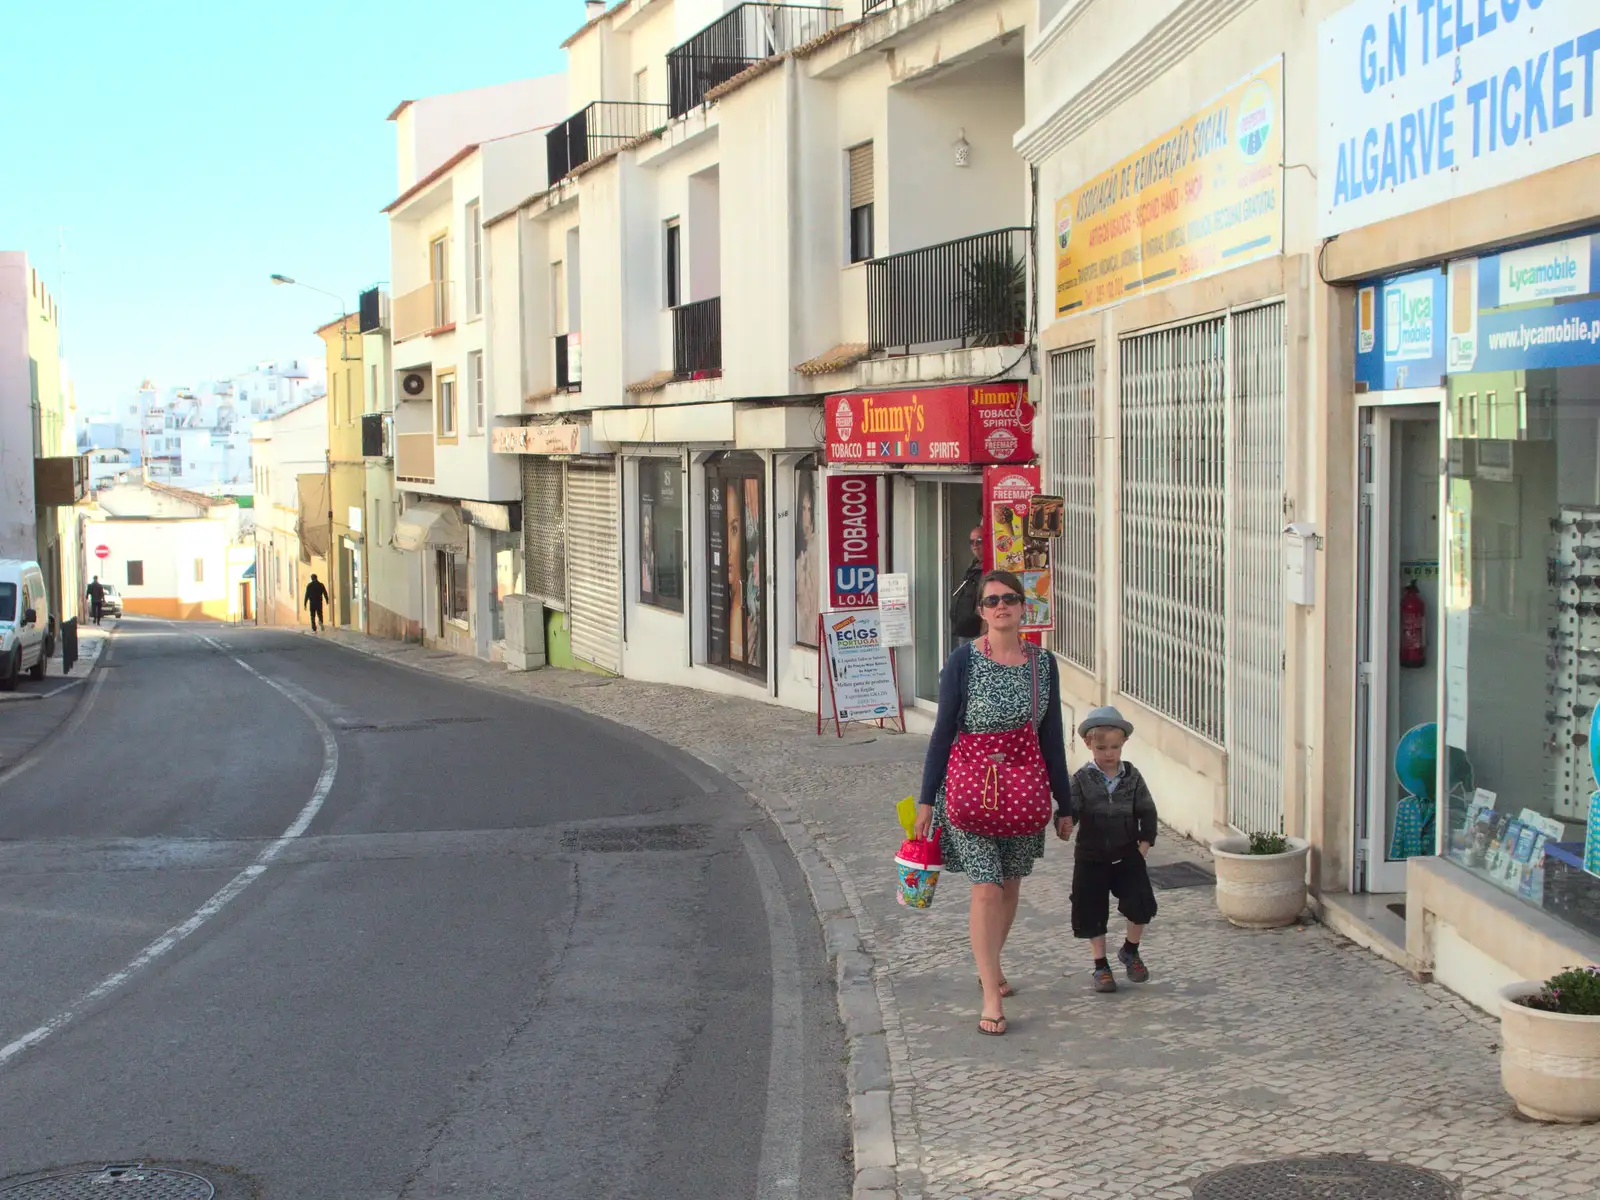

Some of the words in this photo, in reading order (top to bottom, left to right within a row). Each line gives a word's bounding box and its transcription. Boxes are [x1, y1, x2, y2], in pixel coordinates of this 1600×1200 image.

[1360, 5, 1407, 94] G.N
[1417, 0, 1544, 66] TELE
[1454, 55, 1463, 84] &
[1076, 169, 1118, 222] ASSOCIAÇÃO
[1120, 164, 1131, 200] DE
[1134, 125, 1189, 195] REINSERÇÃO
[1191, 105, 1229, 163] SOCIAL
[1333, 94, 1455, 207] ALGARVE
[1137, 197, 1159, 229] SECOND
[1161, 187, 1179, 215] HAND
[1508, 255, 1578, 292] Lycamobile
[1402, 290, 1431, 326] Lyca
[1401, 323, 1431, 345] mobile
[861, 394, 925, 442] Jimmy's
[979, 408, 1022, 419] TOBACCO
[983, 418, 1018, 428] SPIRITS
[831, 442, 863, 458] TOBACCO
[929, 441, 960, 459] SPIRITS
[985, 441, 1018, 450] FREEMAPS
[993, 489, 1035, 500] FREEMAPS
[841, 480, 868, 562] TOBACCO
[837, 567, 875, 590] UP
[838, 594, 874, 605] LOJA
[836, 627, 878, 641] ECIGS
